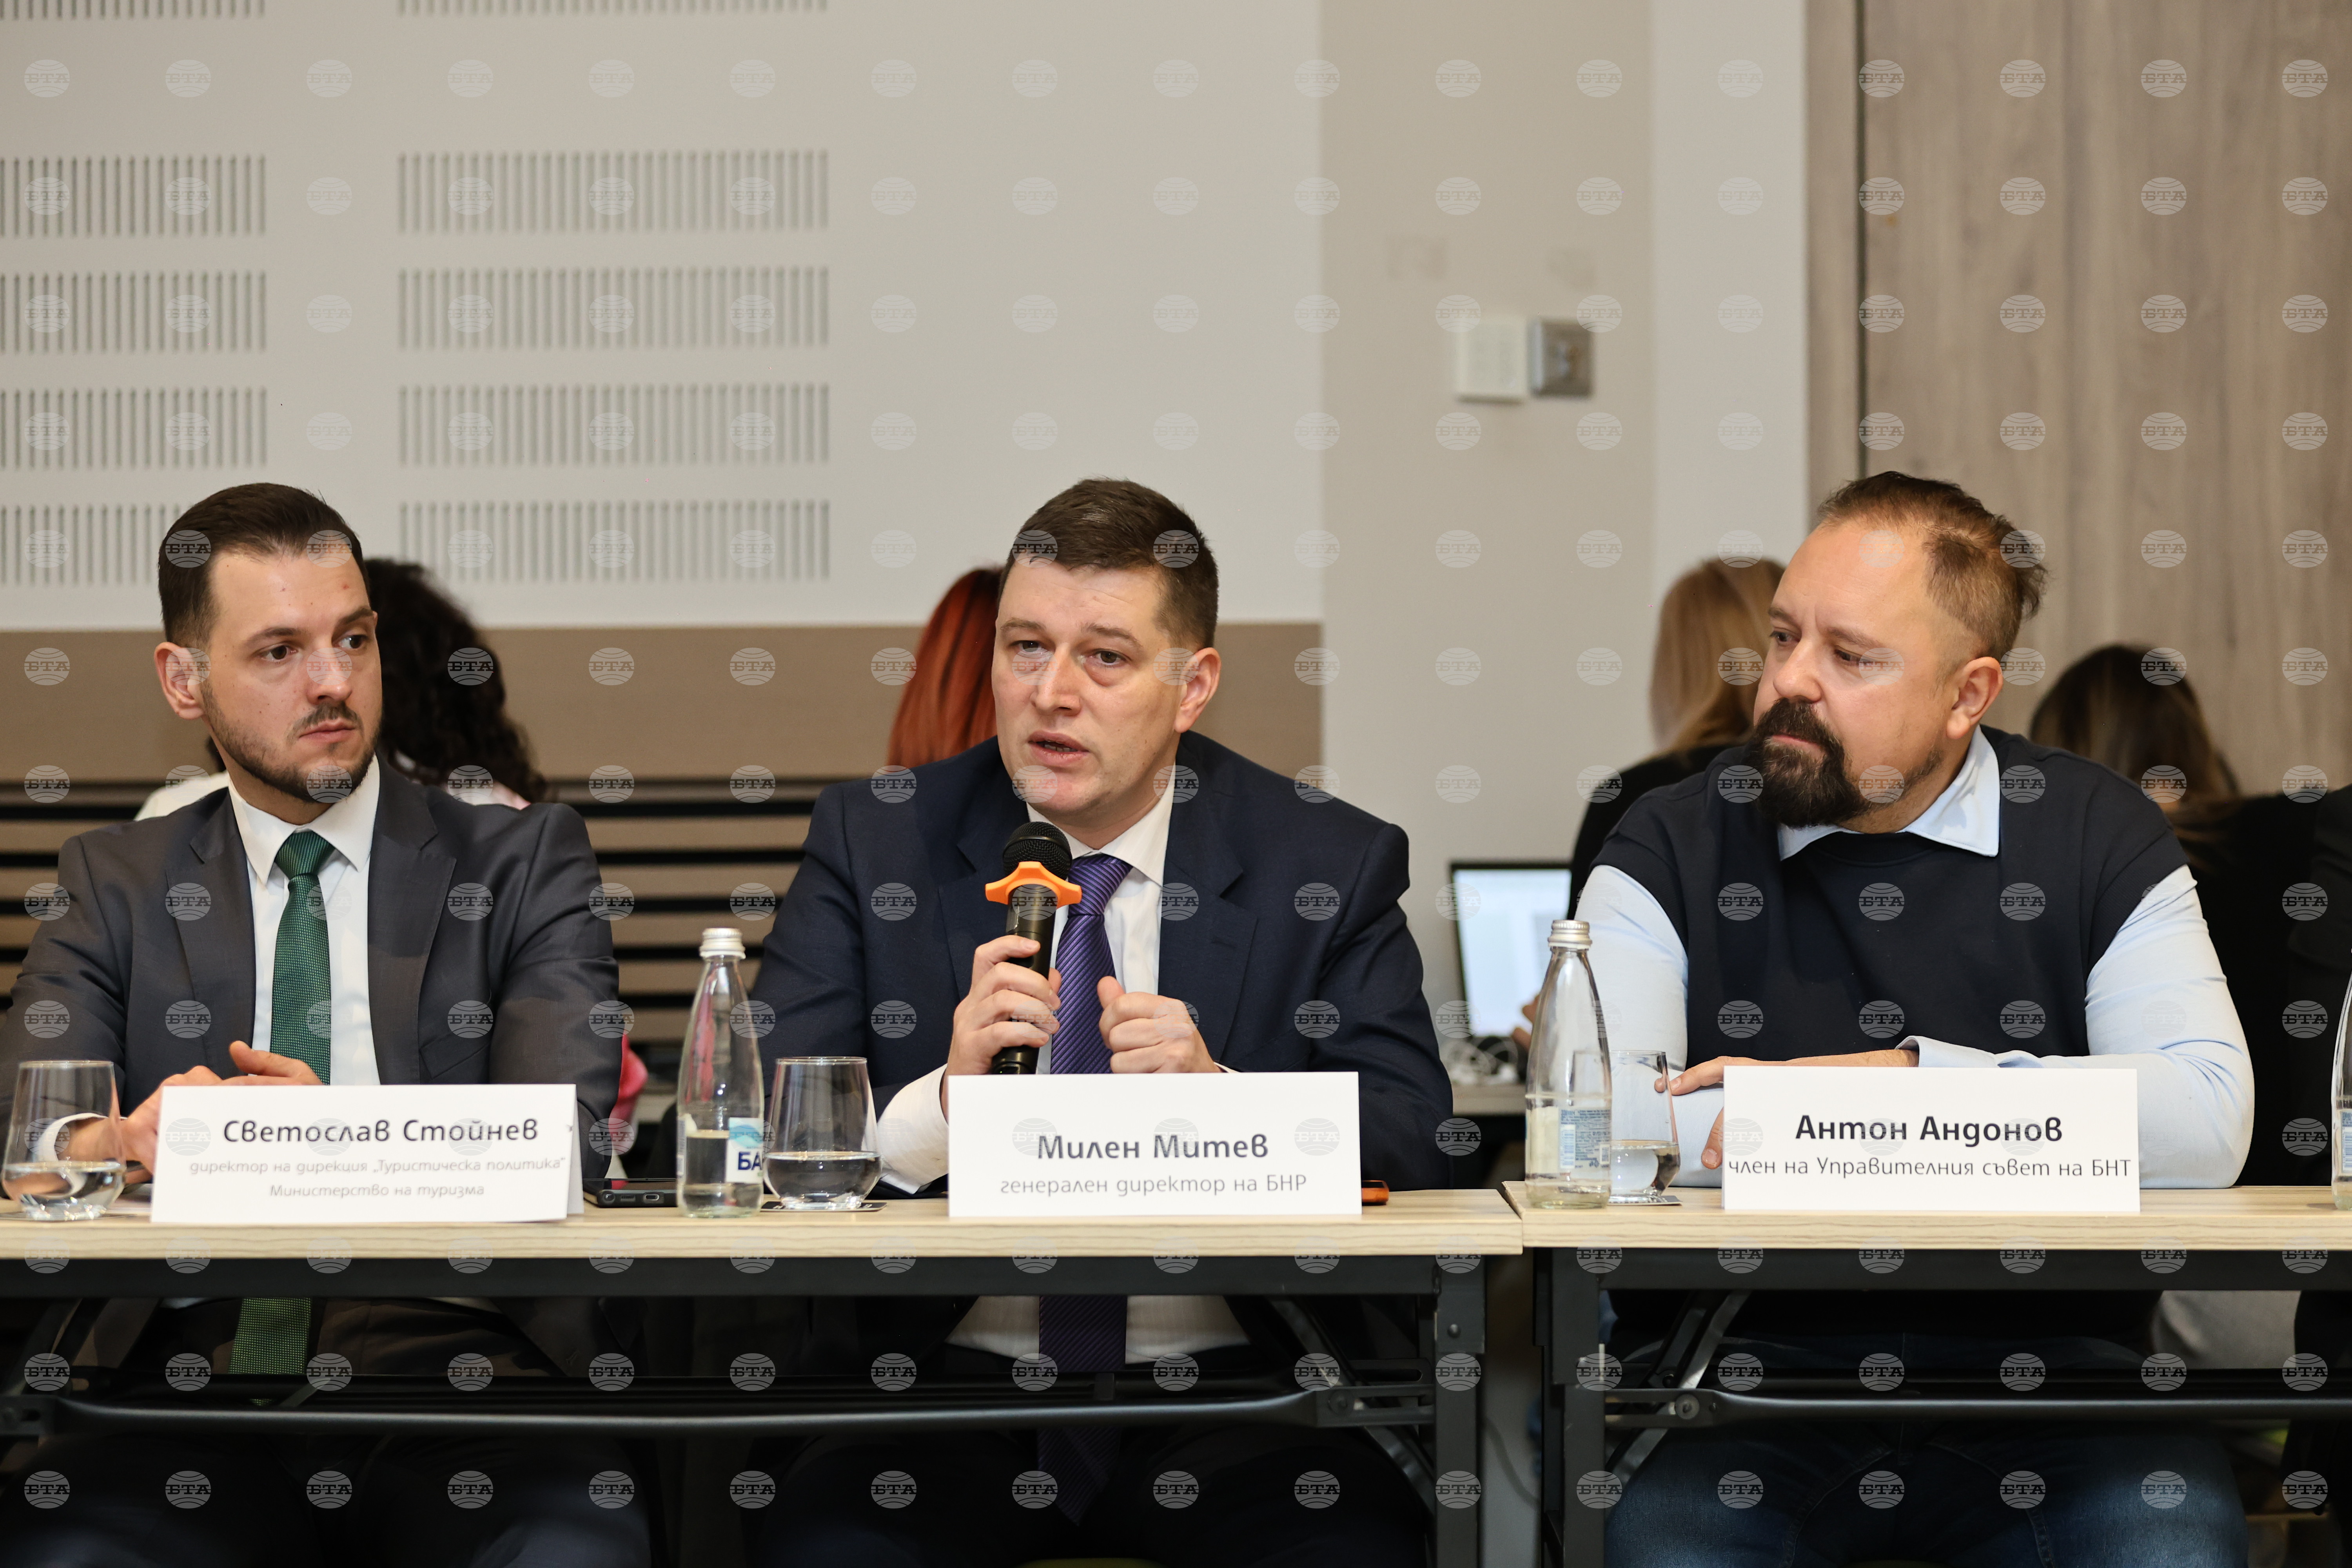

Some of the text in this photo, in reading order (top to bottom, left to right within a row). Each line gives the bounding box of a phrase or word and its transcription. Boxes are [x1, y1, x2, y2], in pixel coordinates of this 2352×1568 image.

[223, 1118, 537, 1143] Светослав Стойнев
[1795, 1114, 2062, 1148] Антон Андонов
[1038, 1133, 1269, 1159] Милен Митев
[189, 1160, 268, 1176] директор
[273, 1161, 291, 1173] на
[296, 1160, 367, 1175] дирекция
[373, 1160, 481, 1174] „Туристическа
[1729, 1157, 2131, 1179] член на Управителния съвет на БНТ
[270, 1184, 485, 1199] Министерство на туризма
[1000, 1174, 1307, 1197] генерален директор на БНР
